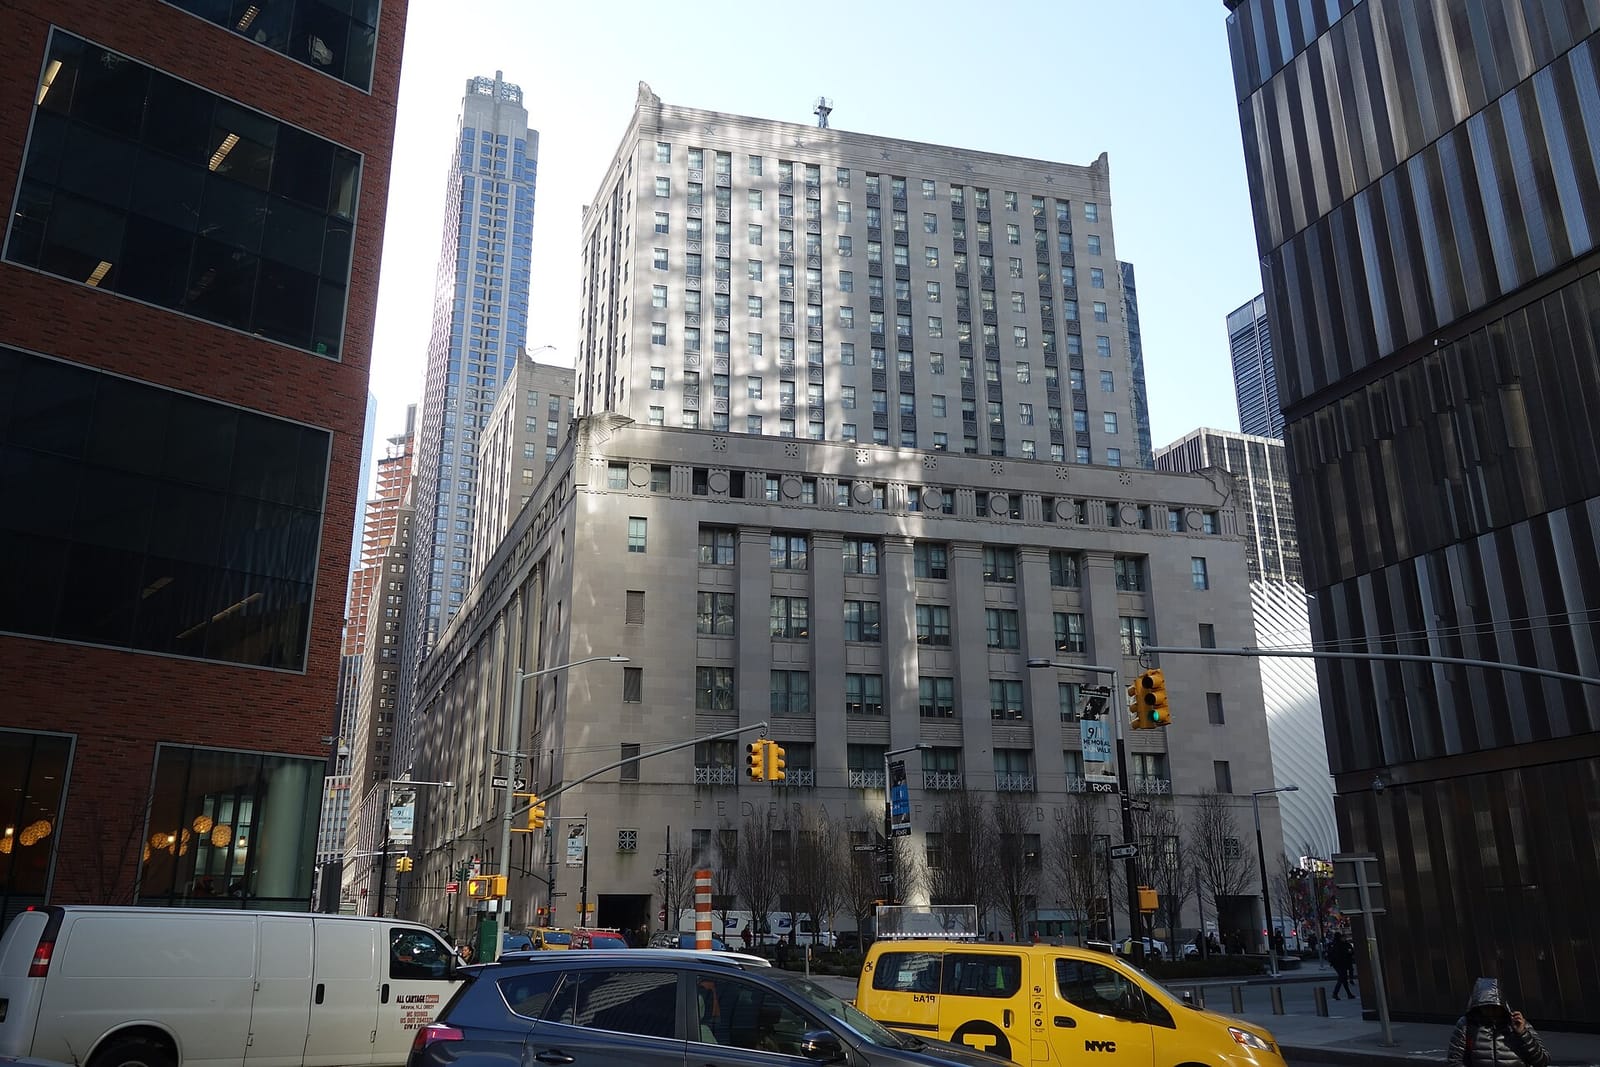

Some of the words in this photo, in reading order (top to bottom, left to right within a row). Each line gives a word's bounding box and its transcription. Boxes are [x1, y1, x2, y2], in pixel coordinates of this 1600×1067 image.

[1092, 783, 1113, 792] RXR
[693, 800, 853, 819] FEDERAL
[396, 995, 404, 1003] ALL
[405, 995, 425, 1003] CARTAGE
[1085, 1040, 1116, 1052] NYC
